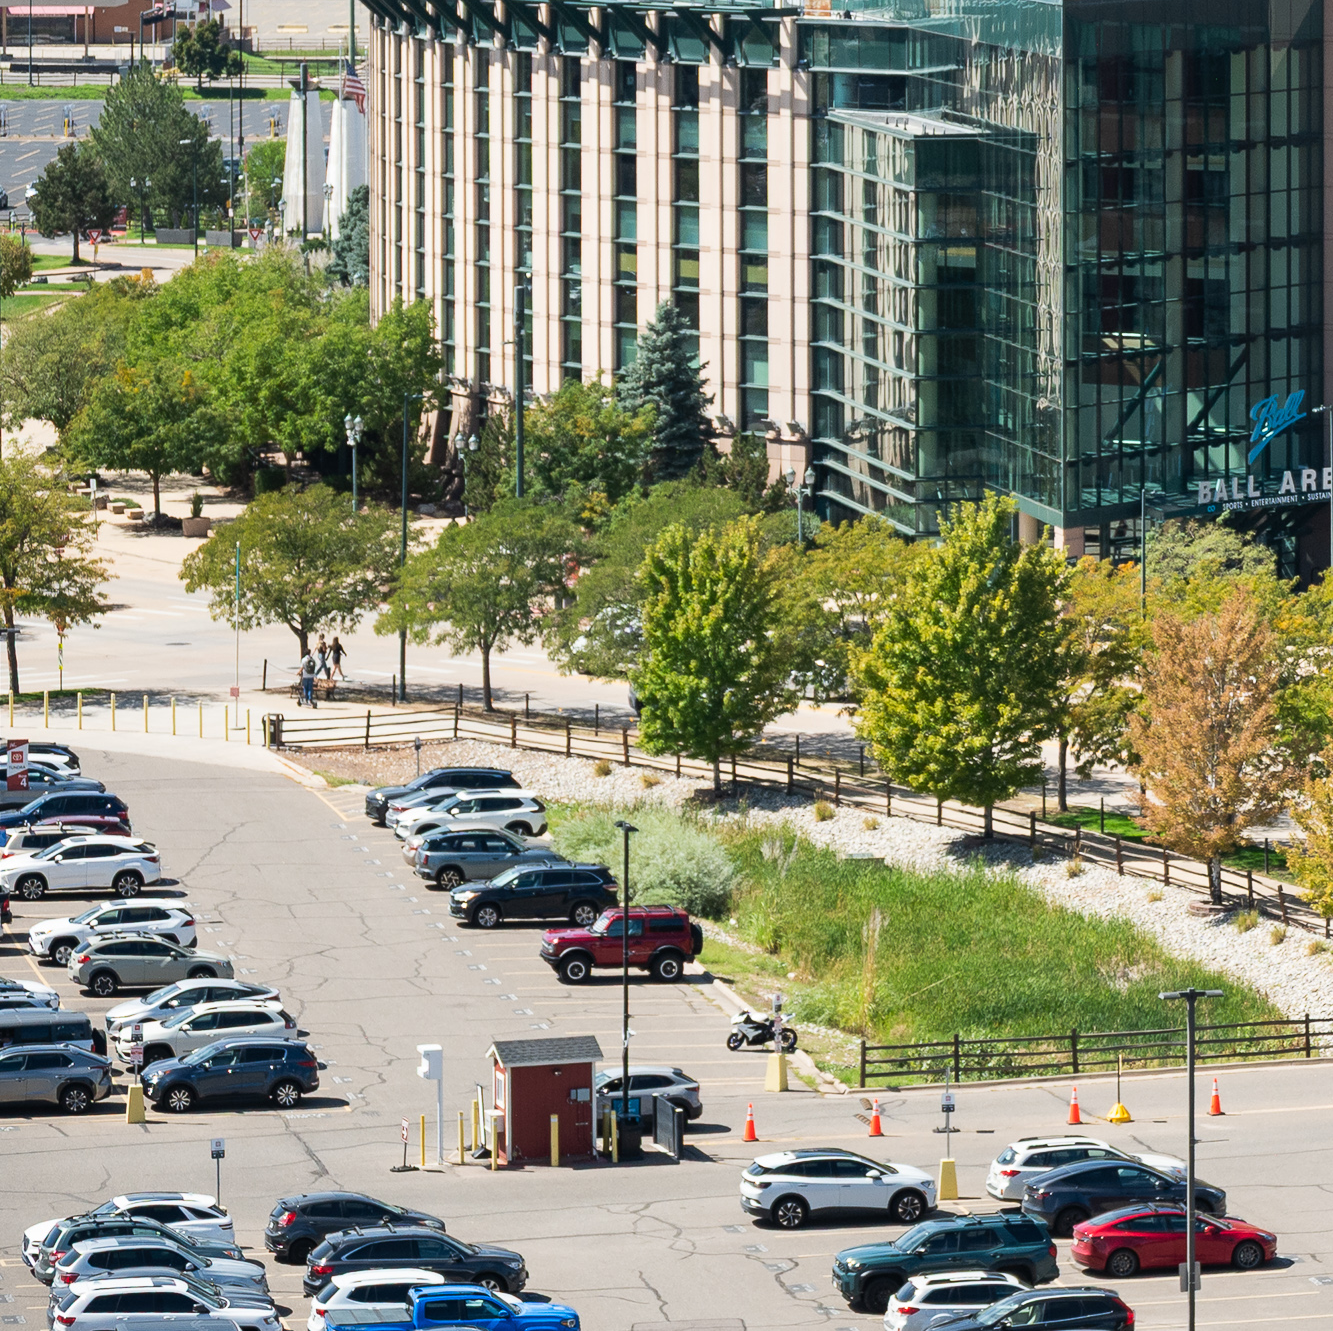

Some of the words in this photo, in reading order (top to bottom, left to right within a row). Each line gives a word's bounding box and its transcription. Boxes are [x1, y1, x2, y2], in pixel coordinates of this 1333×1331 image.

[1249, 389, 1307, 443] Ball
[1197, 474, 1261, 505] BALL
[1222, 500, 1243, 511] SPORTS
[1251, 494, 1298, 508] ENTERTAINMENT
[20, 777, 27, 788] 4
